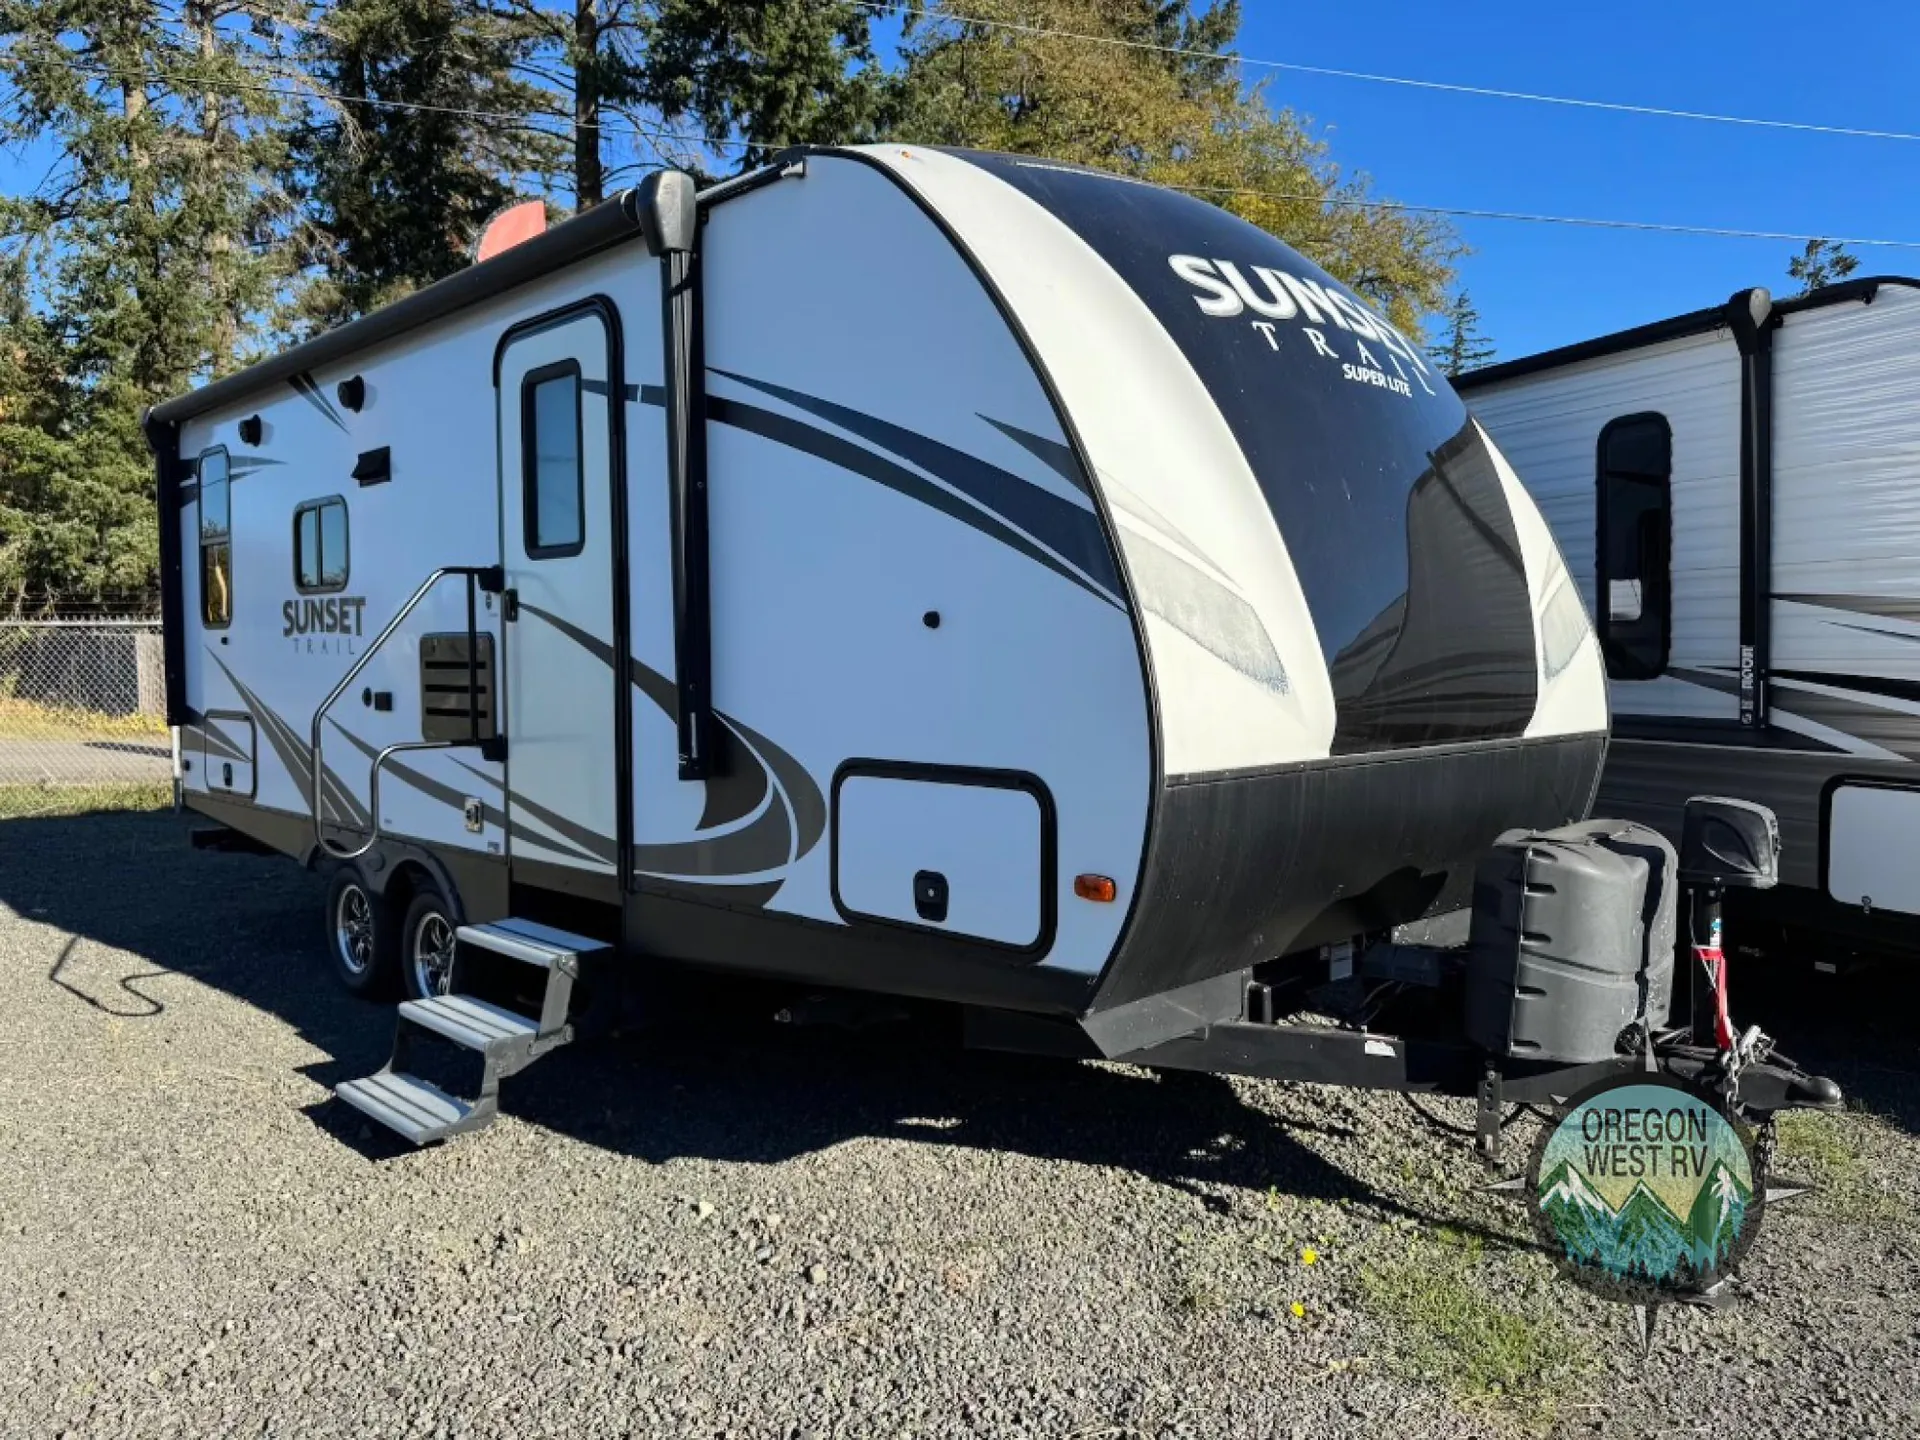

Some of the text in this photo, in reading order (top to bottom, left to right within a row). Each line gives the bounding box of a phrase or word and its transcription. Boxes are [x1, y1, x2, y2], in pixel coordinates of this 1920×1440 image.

[1167, 254, 1430, 376] SUNSET
[1251, 321, 1436, 396] TRAIL
[1341, 362, 1413, 398] SUPER LITE
[282, 596, 367, 637] SUNSET
[293, 637, 355, 655] TRAIL
